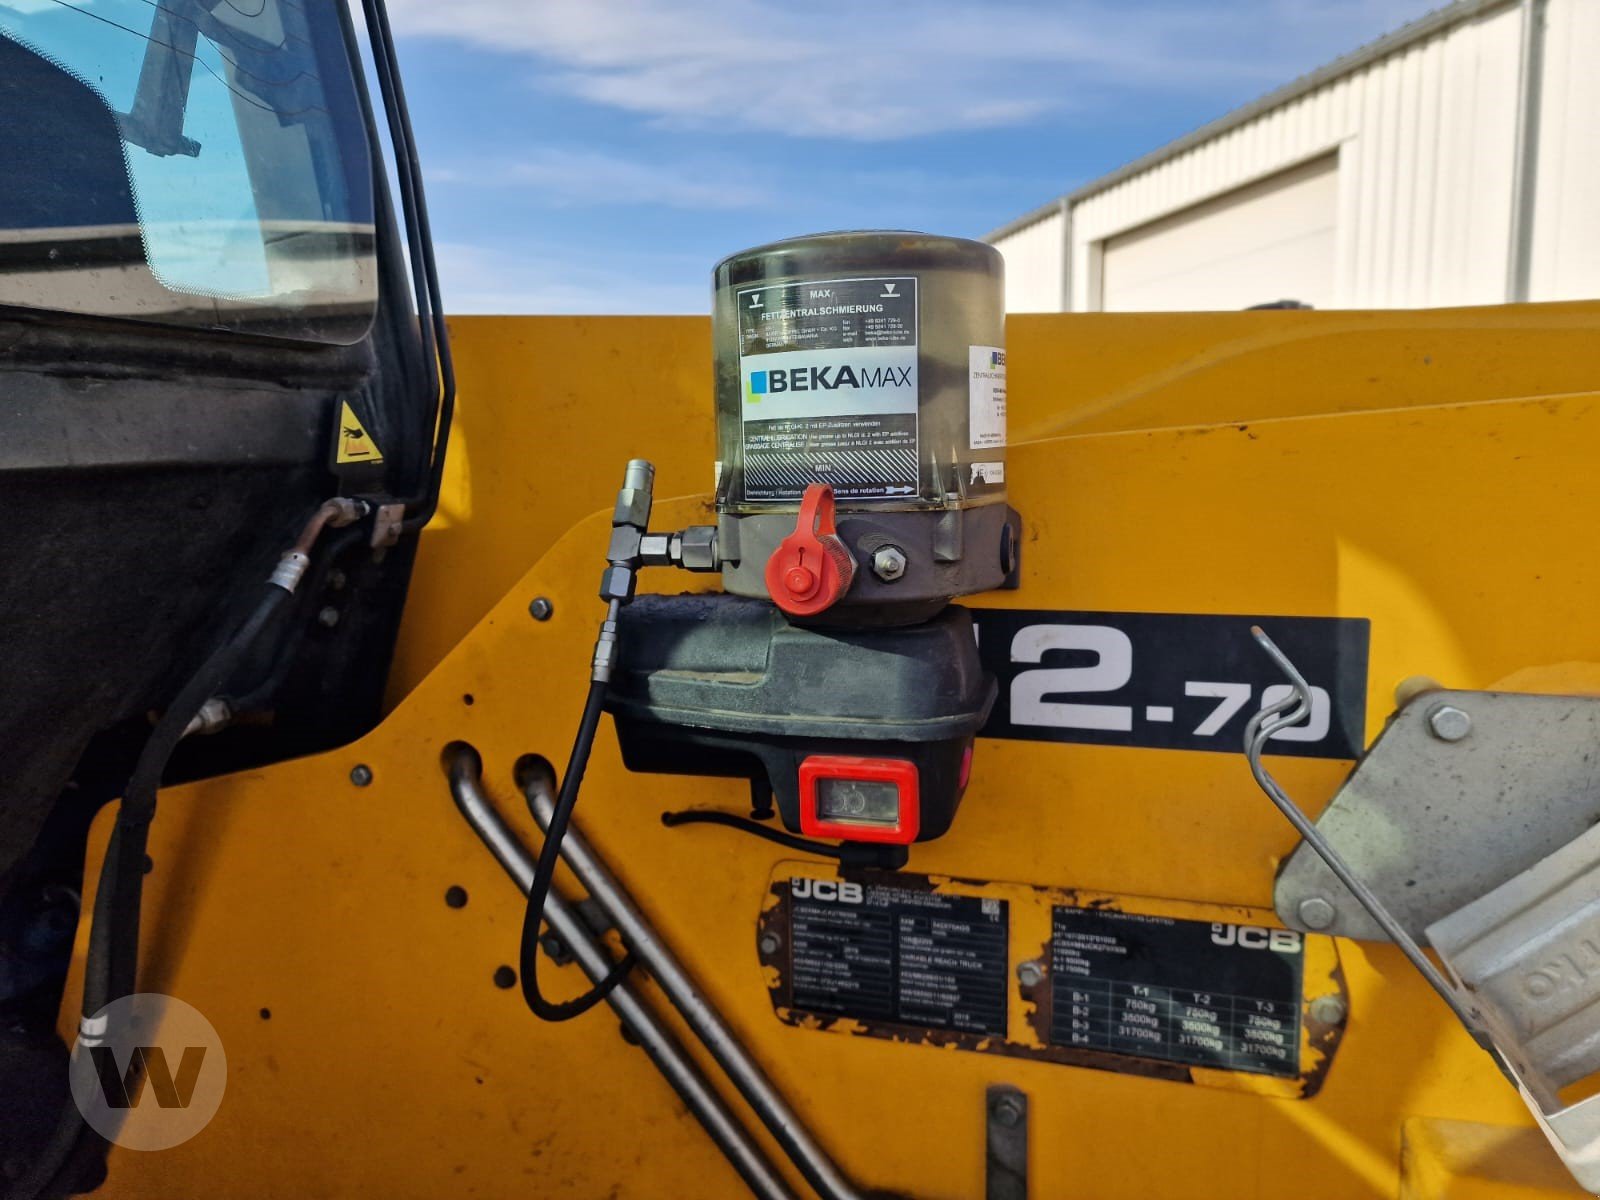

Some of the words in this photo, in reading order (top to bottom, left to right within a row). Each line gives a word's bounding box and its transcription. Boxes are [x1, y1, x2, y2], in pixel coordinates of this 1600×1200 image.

[809, 289, 831, 299] MAX
[761, 304, 884, 321] FETTZENTRALSCHMIERUNG
[769, 365, 912, 393] BEKAMAX
[814, 464, 832, 472] MIN
[792, 877, 863, 904] JCB
[1211, 922, 1301, 953] JCB
[1072, 992, 1089, 1003] B-1
[1125, 998, 1157, 1015] 750kg
[1185, 1006, 1218, 1022] 750kg
[1248, 1014, 1282, 1030] 750kg
[1072, 1005, 1089, 1017] B-2
[1133, 985, 1149, 997] T-1
[1193, 993, 1211, 1004] T-2
[1256, 1001, 1274, 1013] T-3
[1072, 1033, 1089, 1044] B-4
[1072, 1019, 1089, 1031] B-3
[1118, 1025, 1162, 1043] 31700kg
[1179, 1034, 1223, 1051] 31700kg
[1241, 1042, 1286, 1059] 31700kg
